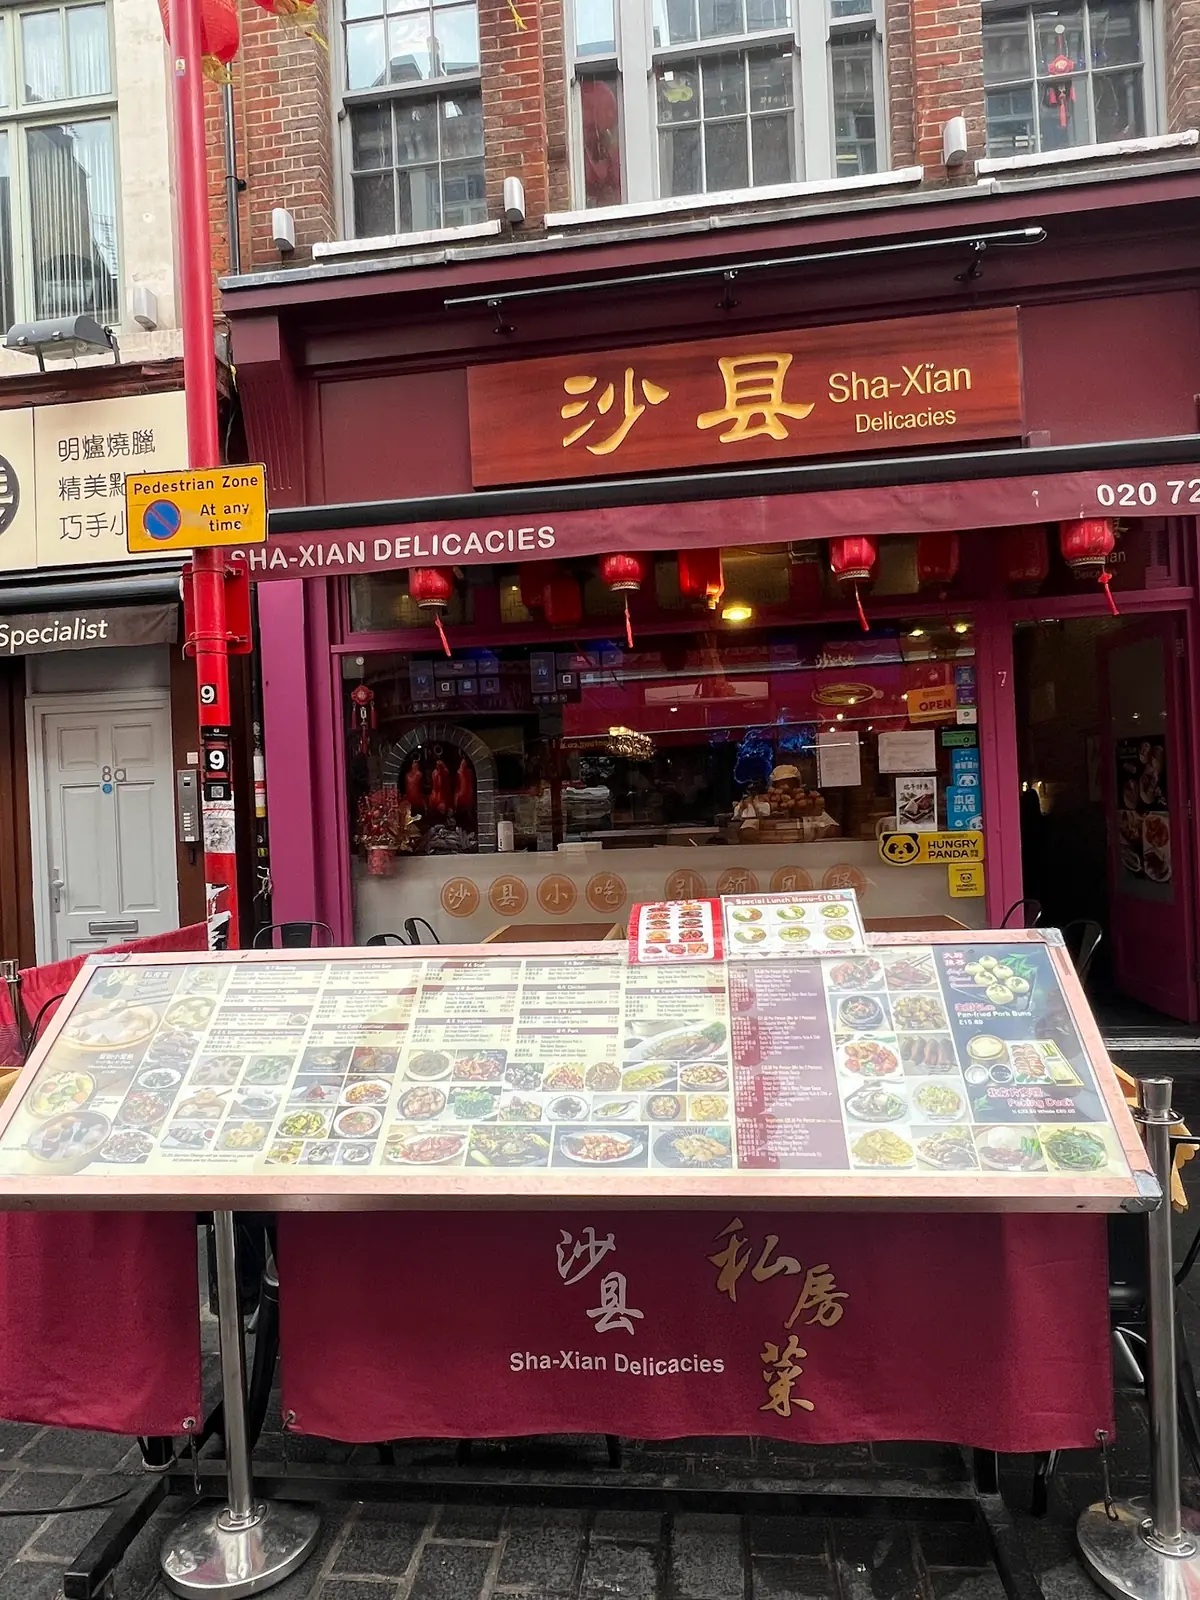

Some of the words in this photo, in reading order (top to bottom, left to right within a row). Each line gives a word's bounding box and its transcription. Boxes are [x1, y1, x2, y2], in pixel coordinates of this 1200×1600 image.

[561, 352, 815, 455] 沙县
[856, 407, 957, 433] Delicacies
[58, 470, 128, 501] 精美點
[133, 477, 214, 496] Pedestrian
[221, 475, 259, 489] Zone
[1096, 482, 1157, 506] 020
[200, 504, 216, 516] At
[223, 503, 250, 515] any
[208, 517, 242, 532] time
[373, 525, 556, 562] DELICACIES
[0, 618, 108, 654] Specialist
[998, 670, 1007, 687] 7
[200, 685, 215, 704] 9
[918, 699, 952, 712] OPEN
[209, 749, 225, 770] 9
[102, 765, 127, 783] 8a
[927, 839, 978, 848] HUNGRY
[928, 849, 969, 859] PANDA
[509, 1350, 607, 1372] Sha-Xian
[614, 1352, 725, 1376] Delicacies
